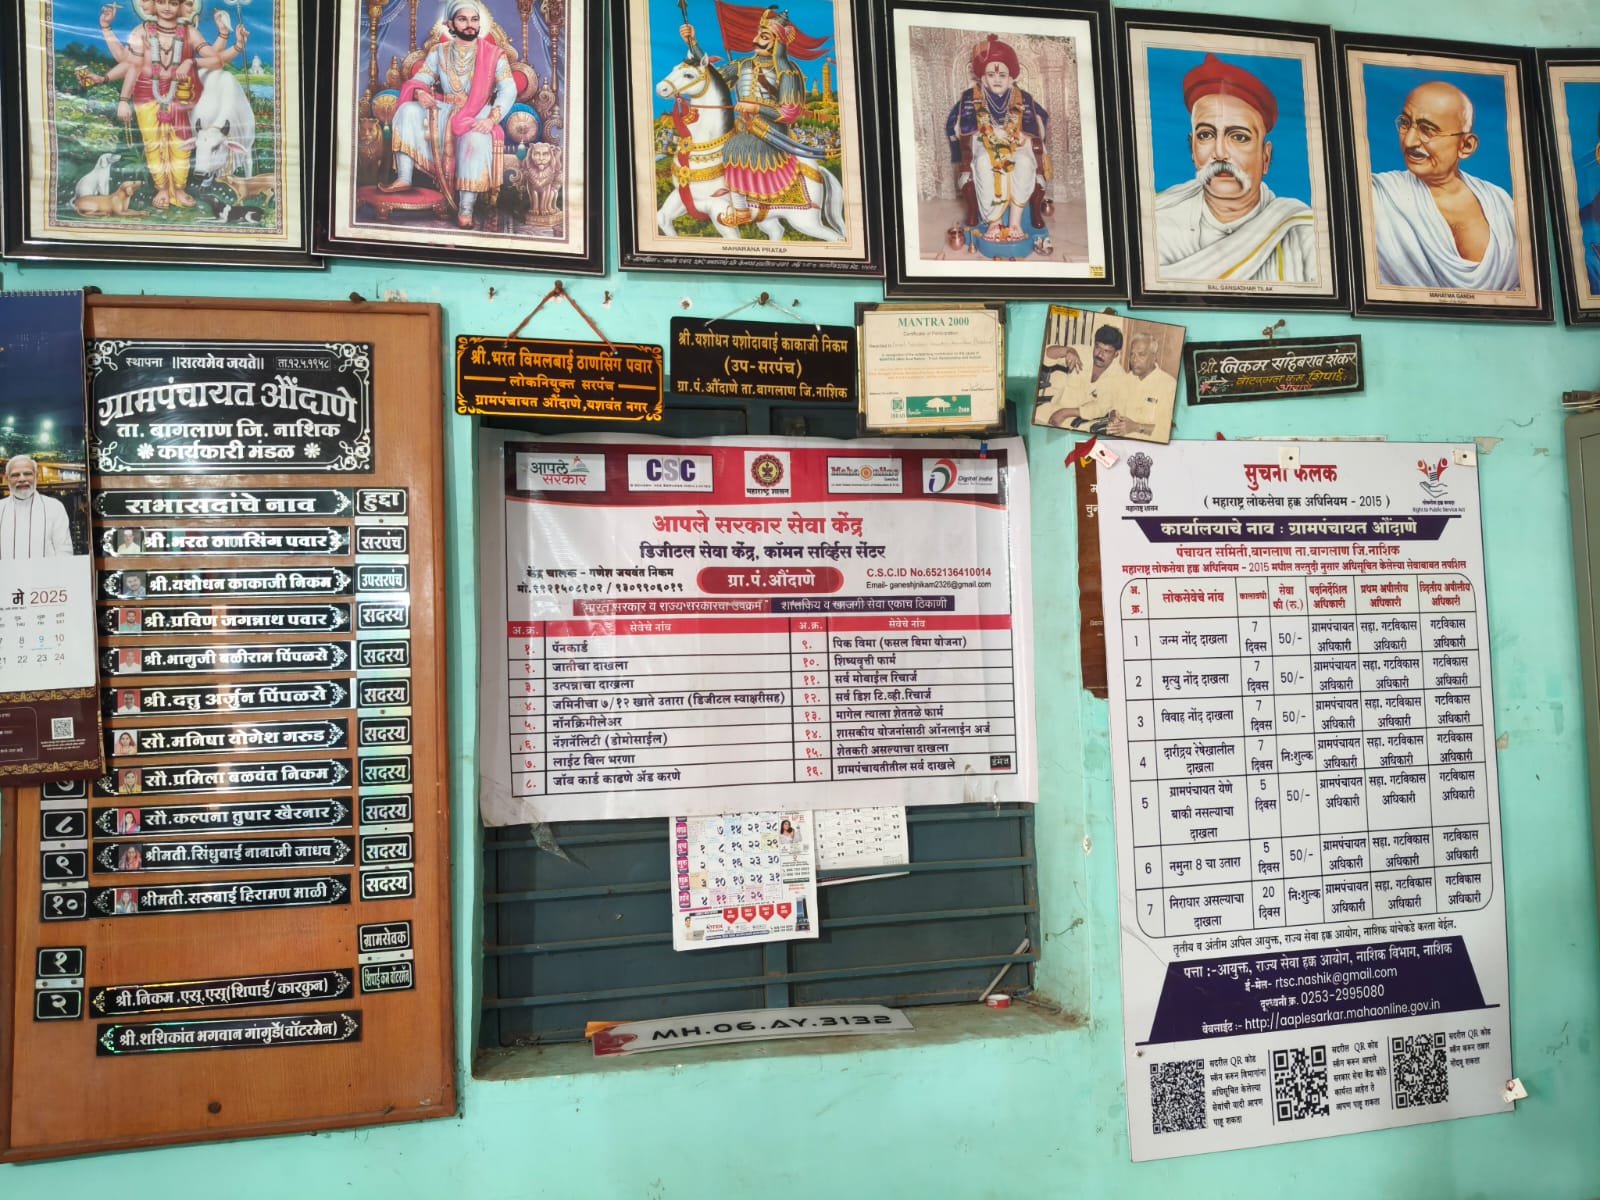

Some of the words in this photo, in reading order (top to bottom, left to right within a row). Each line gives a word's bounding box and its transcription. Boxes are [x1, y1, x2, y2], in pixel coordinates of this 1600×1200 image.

[898, 318, 945, 327] MANTRA
[949, 317, 969, 326] 2000
[679, 328, 728, 348] श्री.यशोधन
[732, 330, 778, 353] यशोदाबाई
[781, 335, 818, 352] काकाजी
[822, 334, 848, 352] निकम
[125, 358, 163, 368] स्थापना
[471, 345, 516, 366] श्री.भरत
[520, 347, 574, 373] विमलबाई
[577, 352, 622, 372] ठाणसिंग
[627, 358, 653, 373] पवार
[724, 355, 802, 379] (उप-सरपंच)
[509, 372, 575, 392] लोकनियुक्त
[581, 377, 614, 391] सरपंच
[98, 376, 256, 426] ग्रामपंचायत
[260, 374, 358, 423] औंदाणे
[475, 392, 538, 407] ग्रामपंचायत
[627, 403, 648, 413] नगर
[117, 424, 144, 438] ता.
[150, 422, 233, 438] बागलाण
[236, 419, 268, 438] जि.
[273, 419, 341, 438] नाशिक
[157, 440, 244, 459] कार्यकारी
[249, 440, 295, 459] मंडळ
[530, 459, 569, 475] आपले
[646, 458, 696, 482] CSC
[542, 474, 587, 486] सरकार
[125, 492, 261, 514] सभासदांचे
[265, 498, 316, 513] नाव
[1212, 497, 1244, 511] महाराष्ट्र
[1246, 493, 1284, 507] लोकसेवा
[1305, 493, 1348, 507] अधिनियम
[1359, 495, 1382, 507] 2015
[652, 510, 710, 534] आपले
[715, 517, 782, 534] सरकार
[787, 511, 827, 534] सेवा
[831, 511, 864, 538] केंद्र
[1160, 517, 1242, 536] कार्यालयाचे
[1246, 522, 1275, 535] नाव
[1288, 518, 1367, 535] ग्रामपंचायत
[1372, 516, 1417, 536] औंदाणे
[144, 533, 209, 550] श्री.भरत
[212, 532, 281, 548] ठाणसिंग
[286, 535, 327, 548] पवार
[361, 531, 402, 549] सरपंच
[640, 541, 695, 559] डिजीटल
[699, 541, 728, 559] सेवा
[731, 541, 759, 562] केंद्र,
[764, 540, 805, 559] कॉमन
[856, 541, 886, 559] सेंटर
[149, 573, 225, 591] श्री.यशोधन
[228, 573, 286, 590] काकाजी
[290, 573, 332, 588] निकम
[362, 569, 402, 588] उपसरपंच
[866, 568, 907, 577] C.S.C.ID
[910, 568, 991, 577] No.652136410014
[866, 581, 887, 589] Email-
[12, 589, 24, 606] मे
[30, 590, 68, 605] 2025
[144, 612, 217, 629] श्री.प्रविण
[221, 614, 285, 627] जगन्नाथ
[287, 614, 327, 627] पवार
[1311, 618, 1354, 632] ग्रामपंचायत
[1360, 622, 1379, 633] सहा.
[1381, 618, 1417, 631] गटविकास
[552, 640, 588, 653] पॅनकार्ड
[1159, 635, 1179, 645] जन्म
[1182, 631, 1198, 647] नोंद
[1200, 634, 1228, 647] दाखला
[1245, 639, 1267, 652] दिवस
[1317, 638, 1352, 652] अधिकारी
[219, 649, 273, 665] बळीराम
[276, 647, 328, 663] पिंपळसे
[877, 653, 897, 665] फार्म
[205, 691, 256, 709] अर्जुन
[259, 687, 327, 704] पिंपळसे
[228, 731, 279, 746] योगेश
[282, 730, 325, 745] गरुड
[552, 734, 601, 748] नॅशनॅलिटी
[604, 732, 668, 747] (डोमोसाईल)
[228, 768, 278, 786] बळवंत
[282, 766, 329, 782] निकम
[144, 809, 228, 826] सौ.कल्पना
[232, 809, 272, 826] तुषार
[274, 804, 330, 821] खैरनार
[244, 843, 292, 861] नानाजी
[294, 844, 331, 858] जाधव
[1169, 860, 1192, 876] नमुना
[1205, 860, 1217, 869] चा
[1219, 856, 1241, 869] उतारा
[240, 884, 291, 902] हिरामण
[293, 881, 328, 899] माळी
[366, 876, 407, 893] सदस्य
[53, 894, 78, 915] १०
[363, 927, 407, 948] ग्रामसेवक
[1184, 966, 1203, 979] पत्ता
[1256, 959, 1277, 972] राज्य
[1281, 954, 1300, 968] सेवा
[1320, 949, 1353, 966] आयोग,
[1356, 947, 1386, 962] नाशिक
[1389, 945, 1420, 959] विभाग,
[1423, 940, 1453, 955] नाशिक
[1275, 966, 1398, 988] rtsc.nashik@gmail.com
[1300, 983, 1385, 1005] 0253-2995080
[1245, 998, 1441, 1031] http://aaplesarkar.mahaonline.gov.in
[120, 1027, 195, 1046] श्री.शशिकांत
[197, 1029, 242, 1043] भगवान
